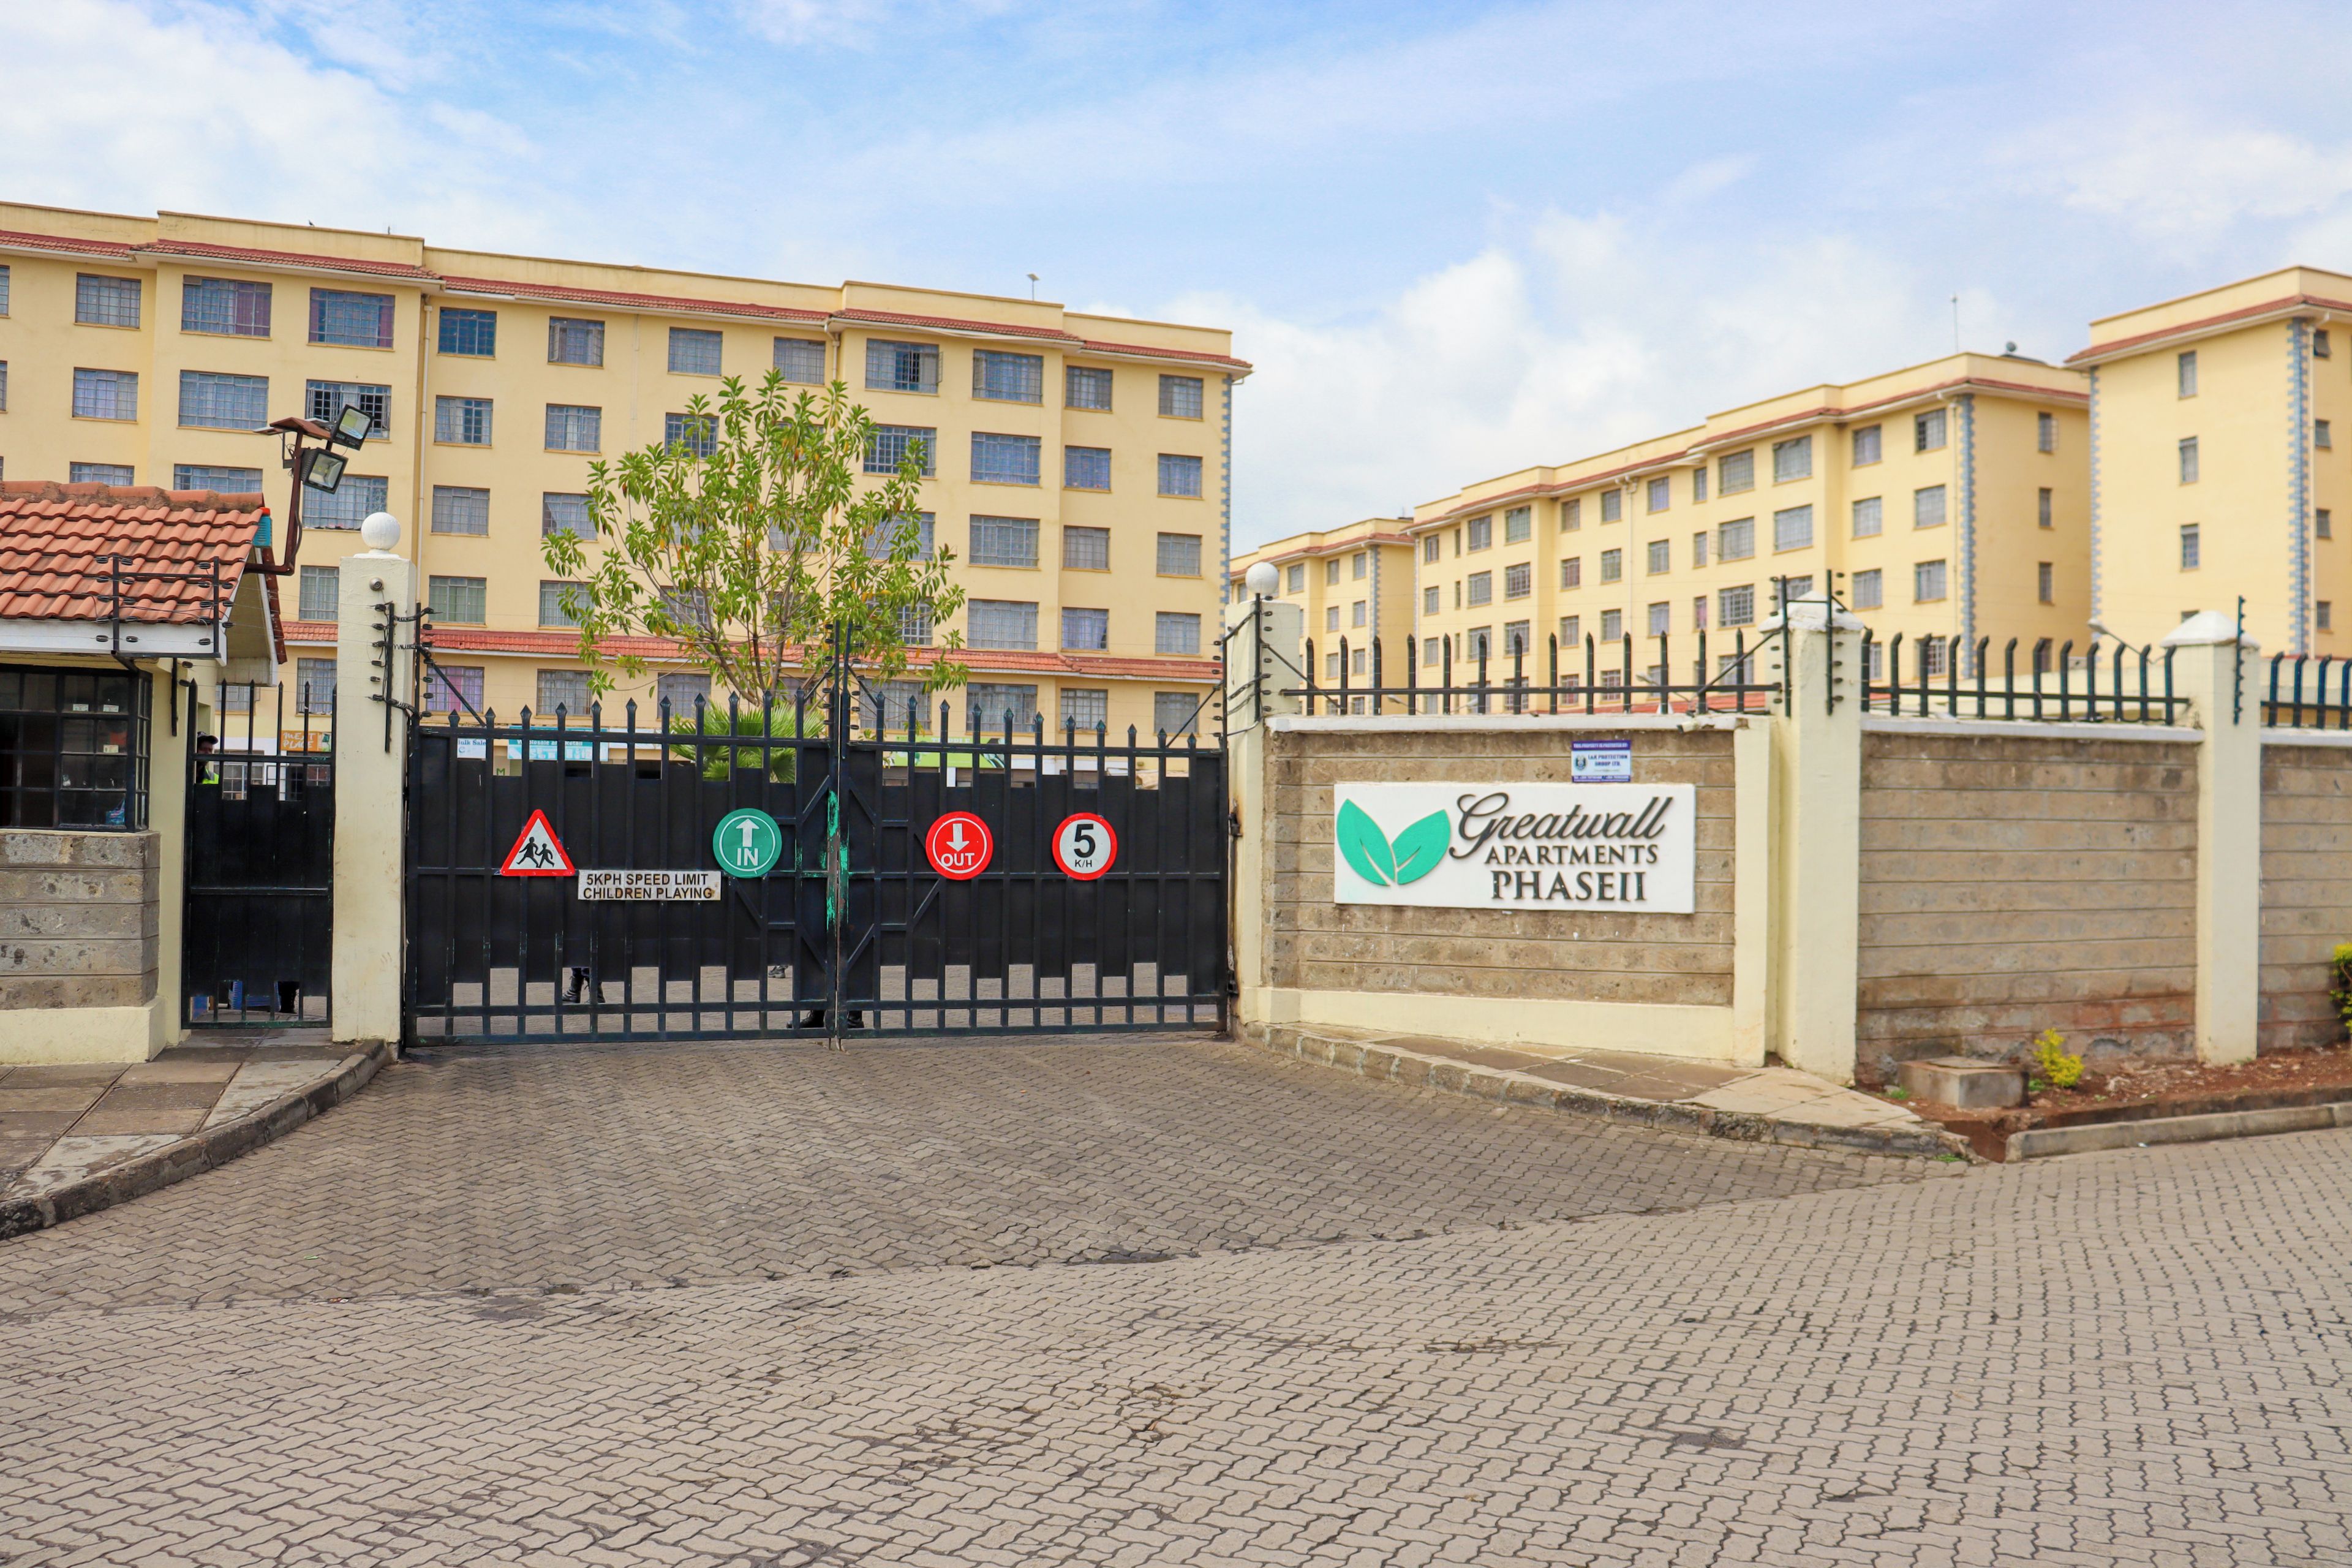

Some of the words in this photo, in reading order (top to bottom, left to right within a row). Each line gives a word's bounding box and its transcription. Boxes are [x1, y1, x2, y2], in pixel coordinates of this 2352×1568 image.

[284, 732, 316, 741] MET
[1449, 792, 1673, 858] Greatwall
[1074, 824, 1096, 858] 5
[737, 848, 758, 866] IN
[941, 853, 975, 867] OUT
[1484, 844, 1659, 864] APARTMENTS
[587, 874, 621, 885] 5KPH
[626, 874, 670, 885] SPEED
[675, 874, 709, 885] LIMIT
[1490, 870, 1648, 901] PHASEII
[583, 888, 652, 899] CHILDREN
[656, 888, 712, 899] PLAYING
